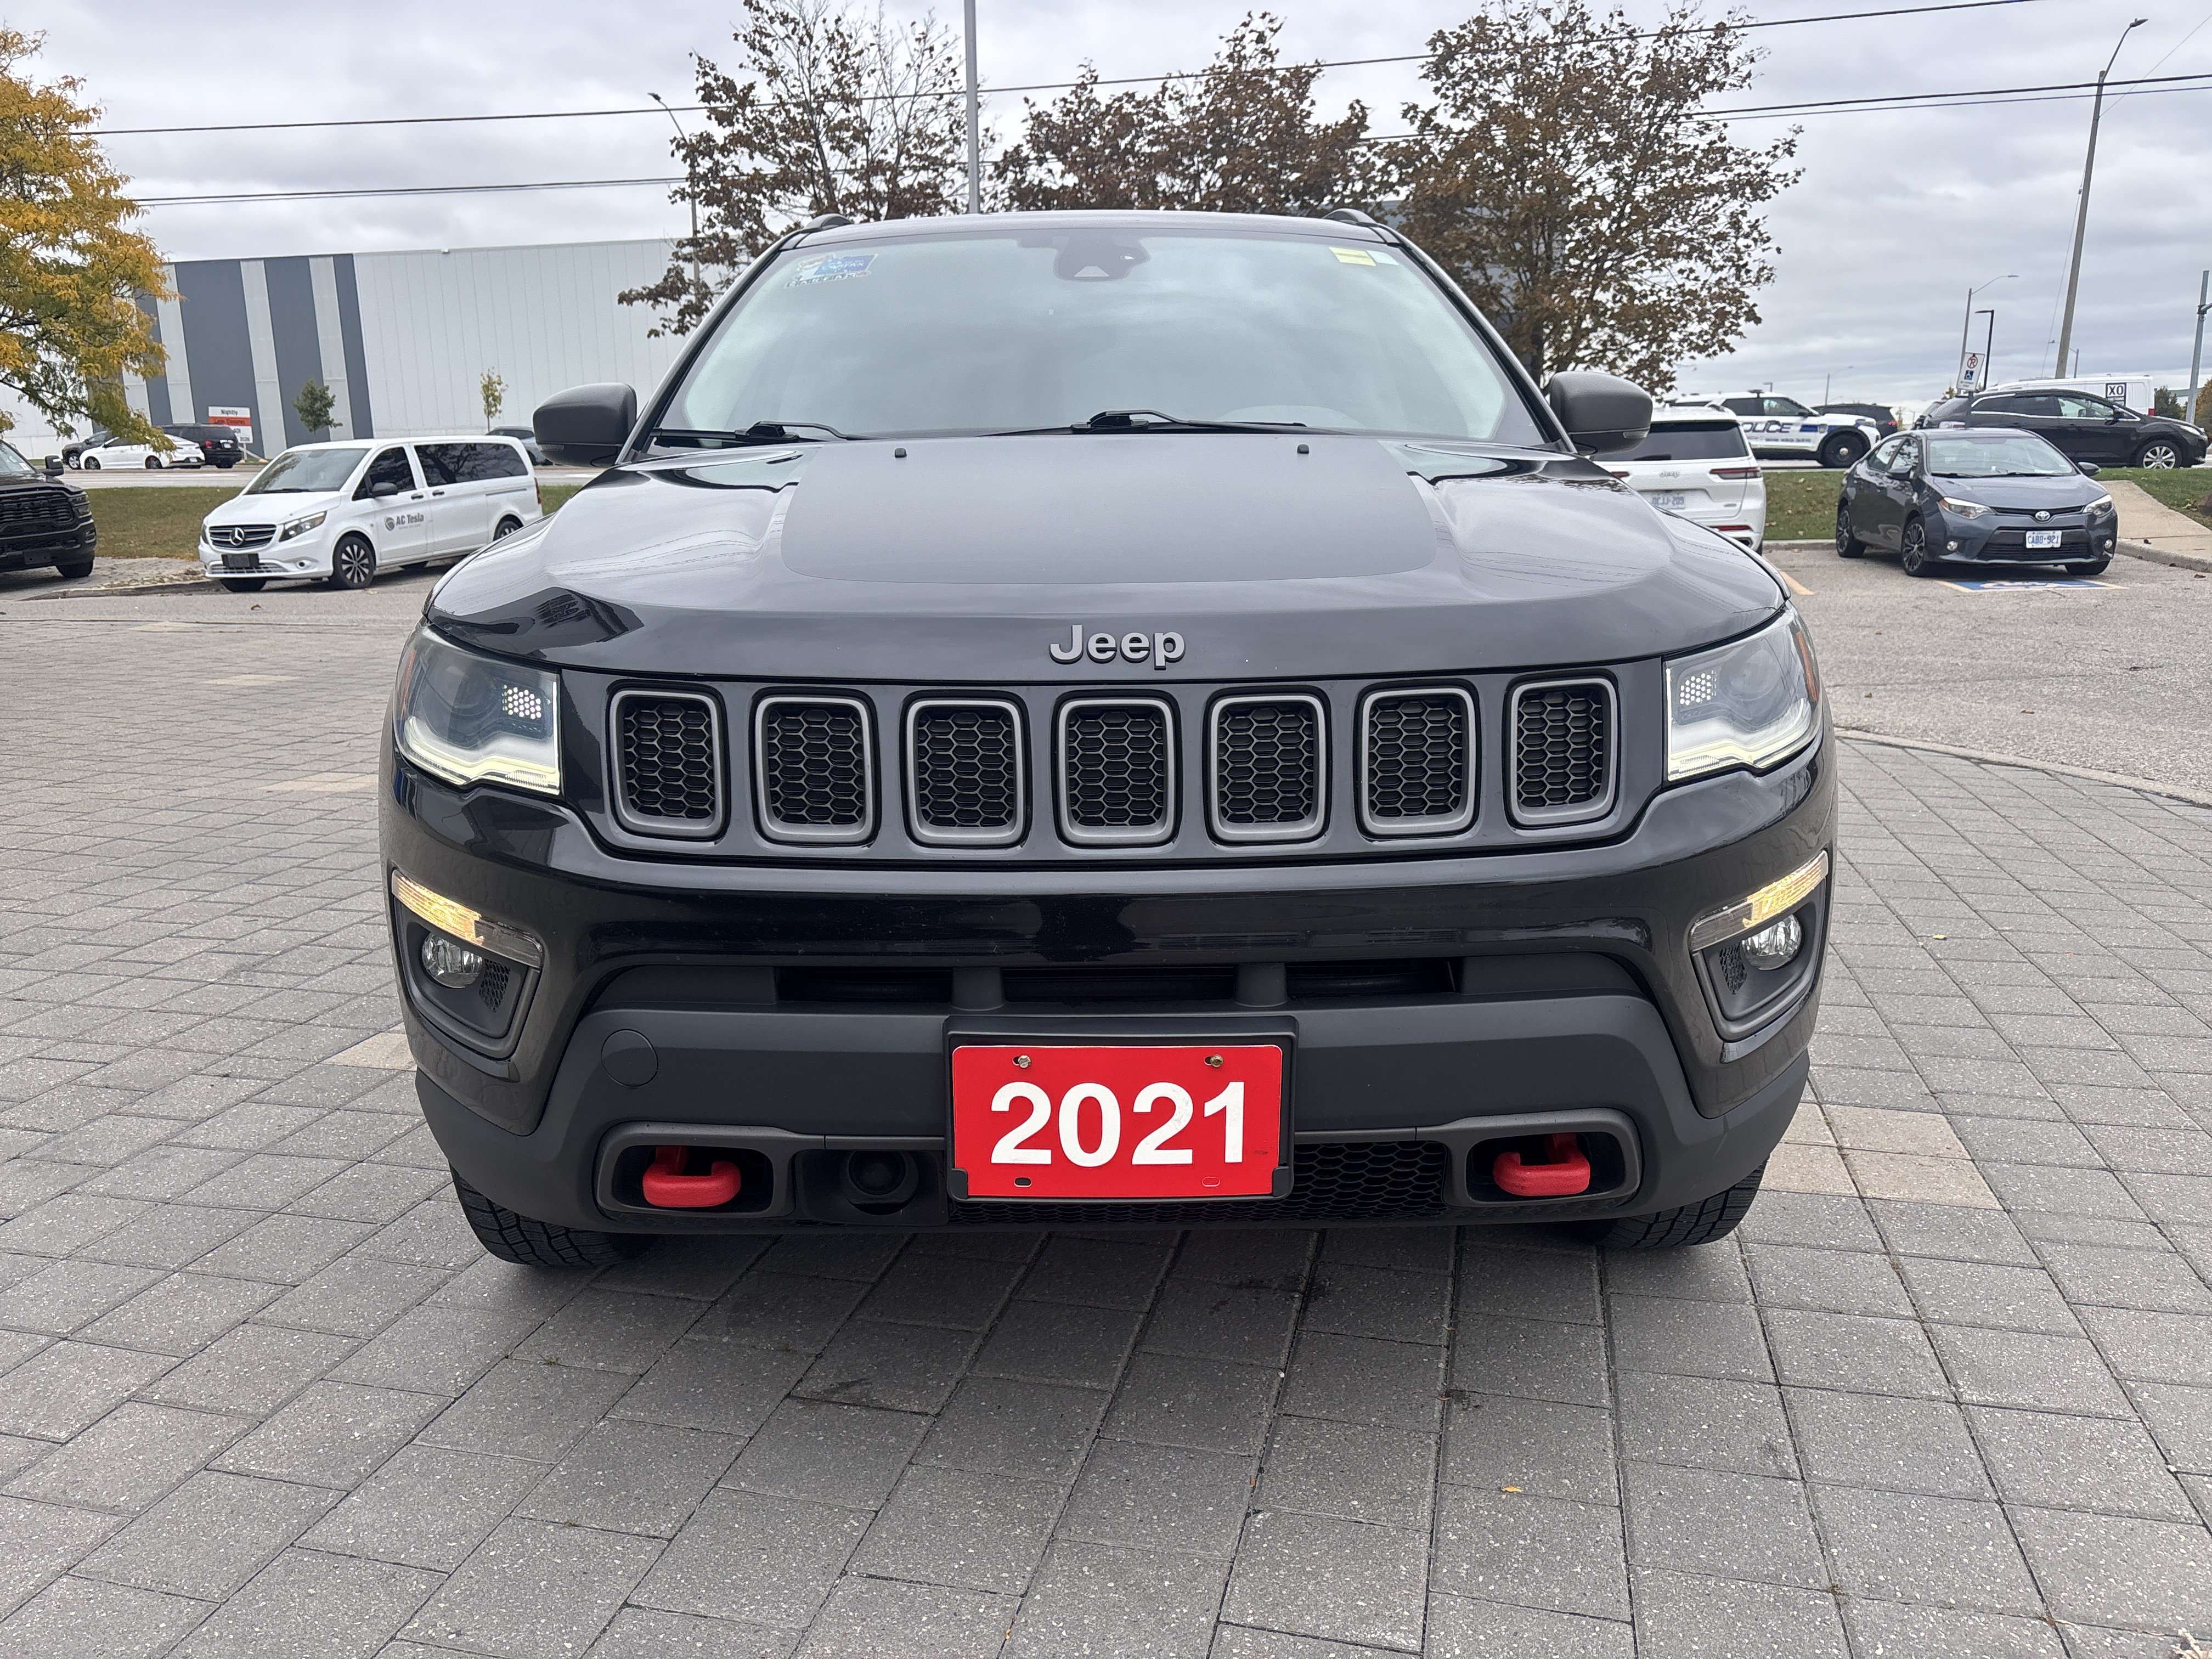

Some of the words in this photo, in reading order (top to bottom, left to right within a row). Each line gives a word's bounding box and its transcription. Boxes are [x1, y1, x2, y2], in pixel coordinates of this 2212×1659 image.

[2109, 385, 2124, 395] XO
[1741, 420, 1793, 433] OLICE
[396, 516, 405, 526] AC
[407, 512, 424, 523] Tesla
[1049, 624, 1186, 670] Jeep
[991, 1081, 1245, 1167] 2021
